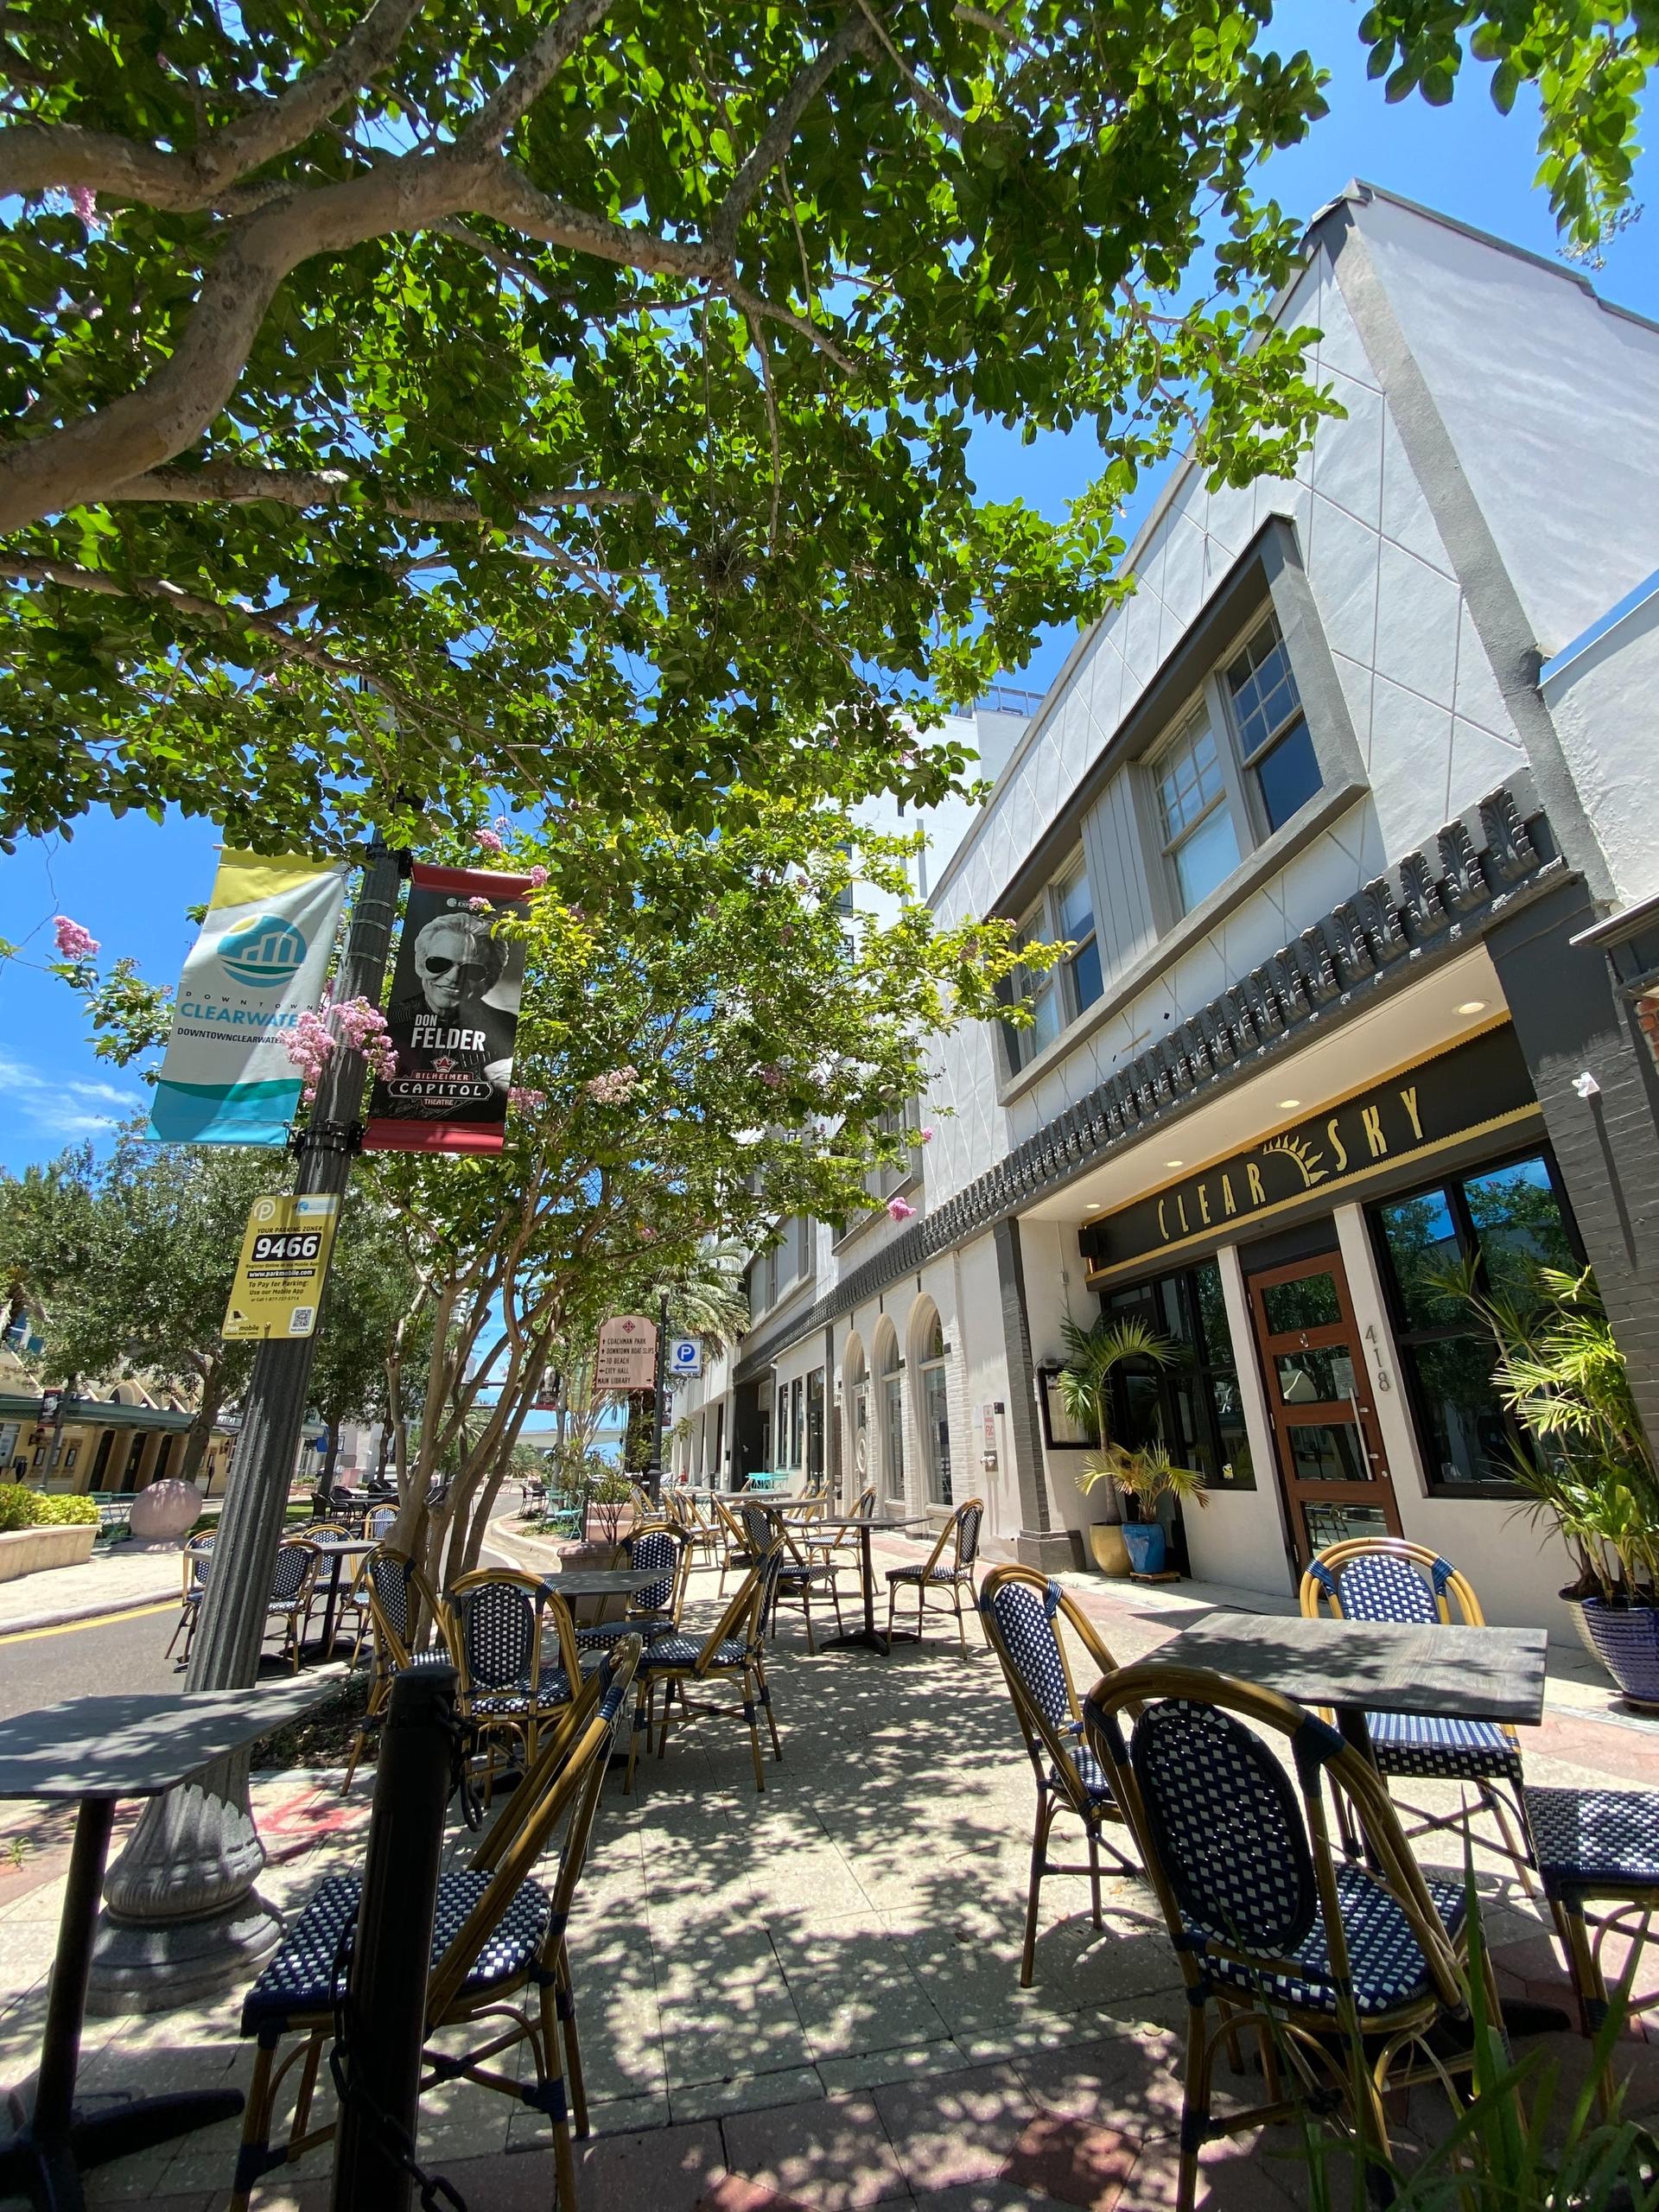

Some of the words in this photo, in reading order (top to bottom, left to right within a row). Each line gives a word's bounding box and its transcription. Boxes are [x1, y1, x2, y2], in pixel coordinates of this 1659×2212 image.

[186, 991, 314, 1010] DOWNTOWN
[181, 1002, 299, 1028] CLEARWATE
[415, 1014, 437, 1027] DON
[410, 1027, 486, 1052] FELDER
[415, 1072, 469, 1081] BILHEIMER
[398, 1083, 482, 1096] CAPITOL
[1157, 1162, 1266, 1240] CLEAR
[1326, 1086, 1423, 1171] SKY
[255, 1236, 318, 1259] 9466
[249, 1269, 313, 1278] www.parkmobile.com
